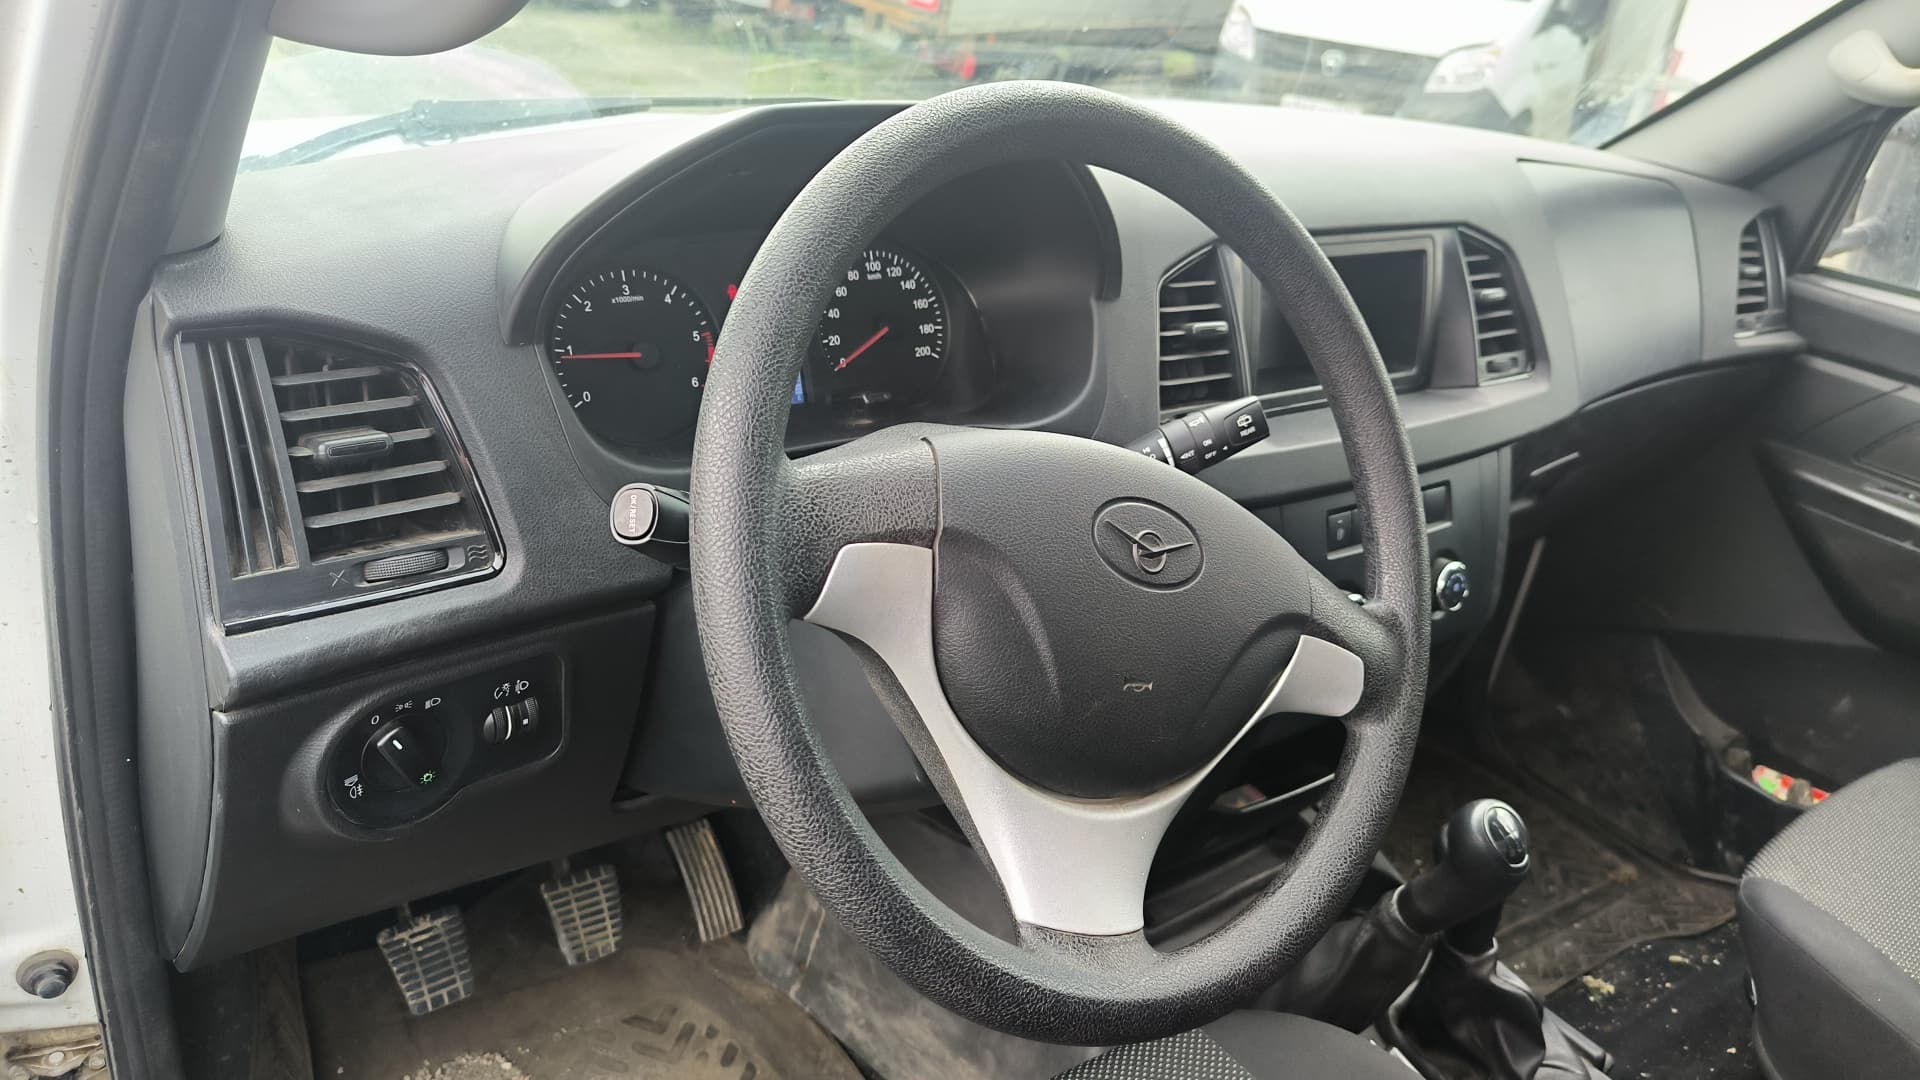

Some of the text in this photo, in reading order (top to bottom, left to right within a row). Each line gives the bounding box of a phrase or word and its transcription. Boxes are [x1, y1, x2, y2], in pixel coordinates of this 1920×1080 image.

[865, 261, 881, 272] 100
[847, 271, 859, 281] 80
[886, 267, 902, 278] 120
[621, 284, 630, 295] 3
[900, 280, 916, 290] 140
[835, 286, 847, 297] 60
[664, 293, 672, 304] 4
[584, 301, 592, 312] 2
[913, 299, 929, 310] 160
[828, 308, 840, 319] 40
[919, 324, 935, 335] 180
[692, 331, 701, 342] 5
[828, 335, 841, 346] 20
[915, 346, 931, 357] 200
[691, 376, 699, 387] 6
[583, 391, 591, 402] 0
[1204, 450, 1217, 459] OFF
[628, 494, 637, 533] OK/RESET
